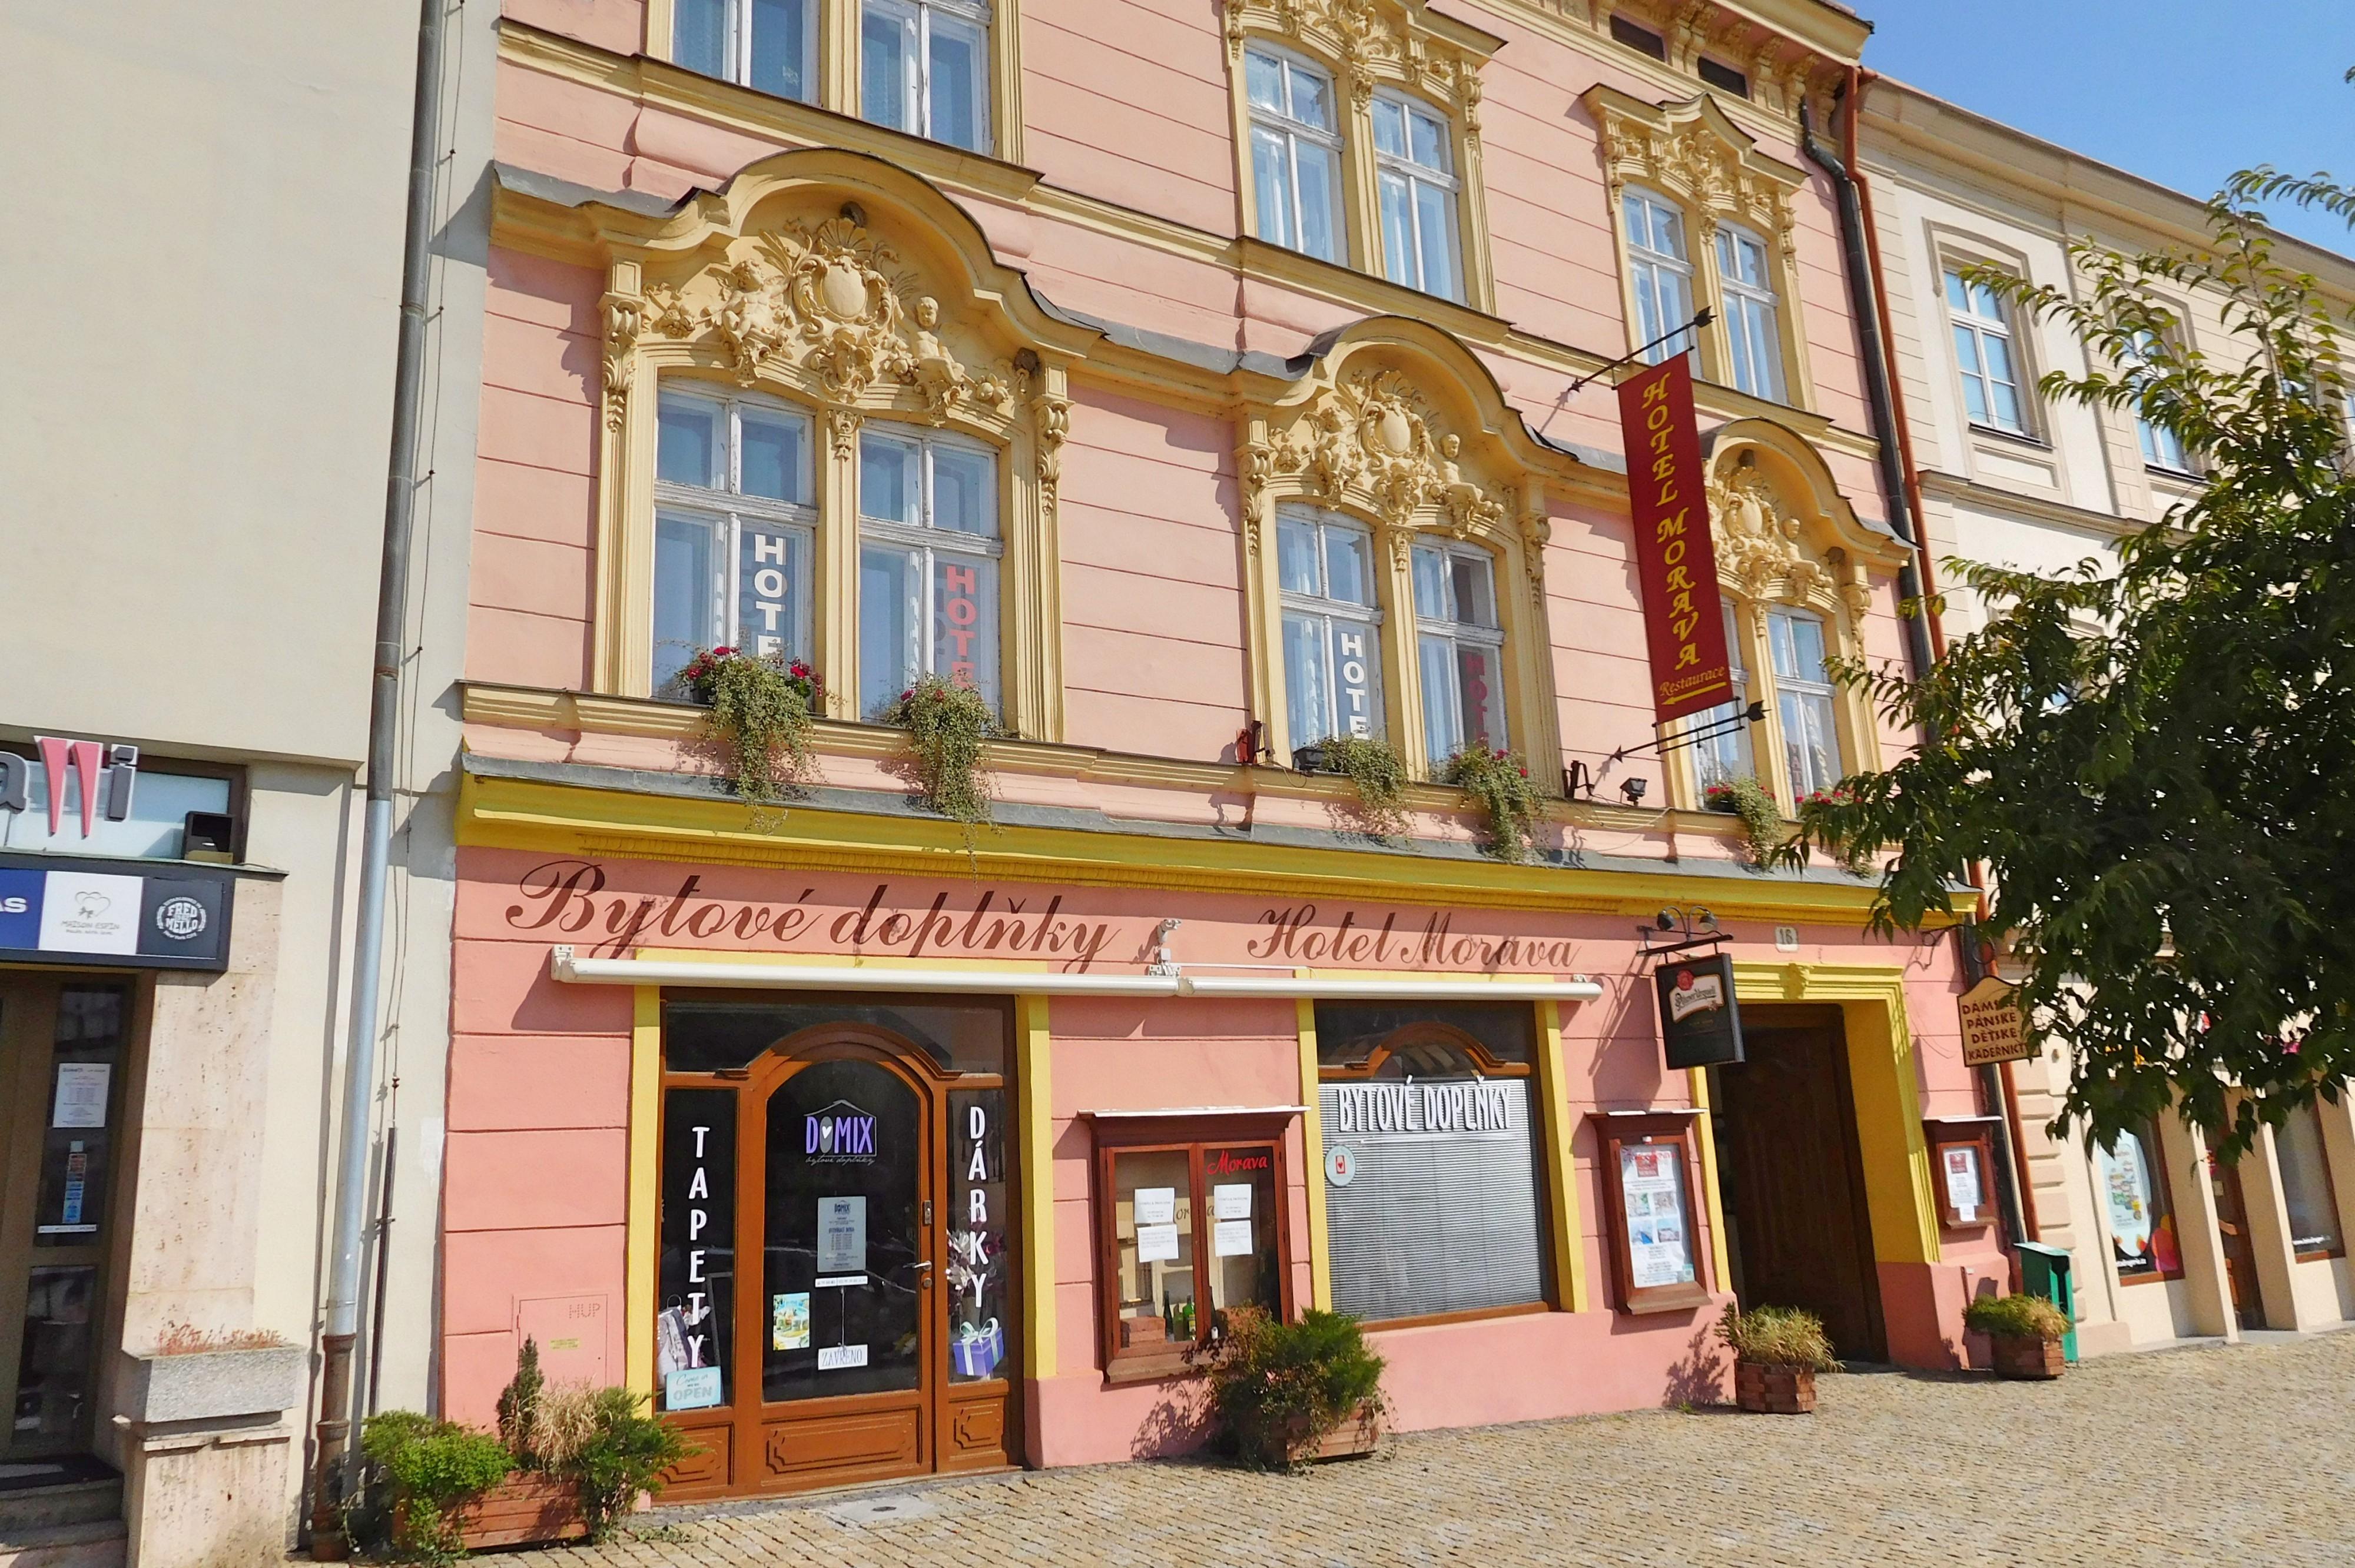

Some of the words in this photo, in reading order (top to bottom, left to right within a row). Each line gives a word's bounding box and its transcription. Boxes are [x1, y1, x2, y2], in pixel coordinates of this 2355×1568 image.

[1641, 371, 1679, 507] HOTEL
[754, 534, 787, 659] HOTE
[1657, 506, 1701, 670] MORAVA
[946, 565, 977, 688] HOTE
[1341, 632, 1369, 740] HOTE
[1660, 666, 1726, 696] Restaurace
[165, 918, 198, 934] MELLO
[167, 902, 198, 918] FRED
[506, 860, 823, 959] Bytové
[830, 884, 1122, 974] doplňky
[1247, 904, 1400, 962] Hotel
[1400, 910, 1582, 967] Morava
[1339, 1074, 1418, 1132] BYTOVÉ
[1424, 1075, 1511, 1131] DOPLŇKY
[806, 1116, 873, 1154] DOMIX
[1206, 1149, 1268, 1176] Morava
[968, 1107, 988, 1308] DÁRKY
[687, 1127, 710, 1368] TAPETY
[569, 1303, 601, 1318] HUP
[674, 1386, 712, 1401] OPEN
